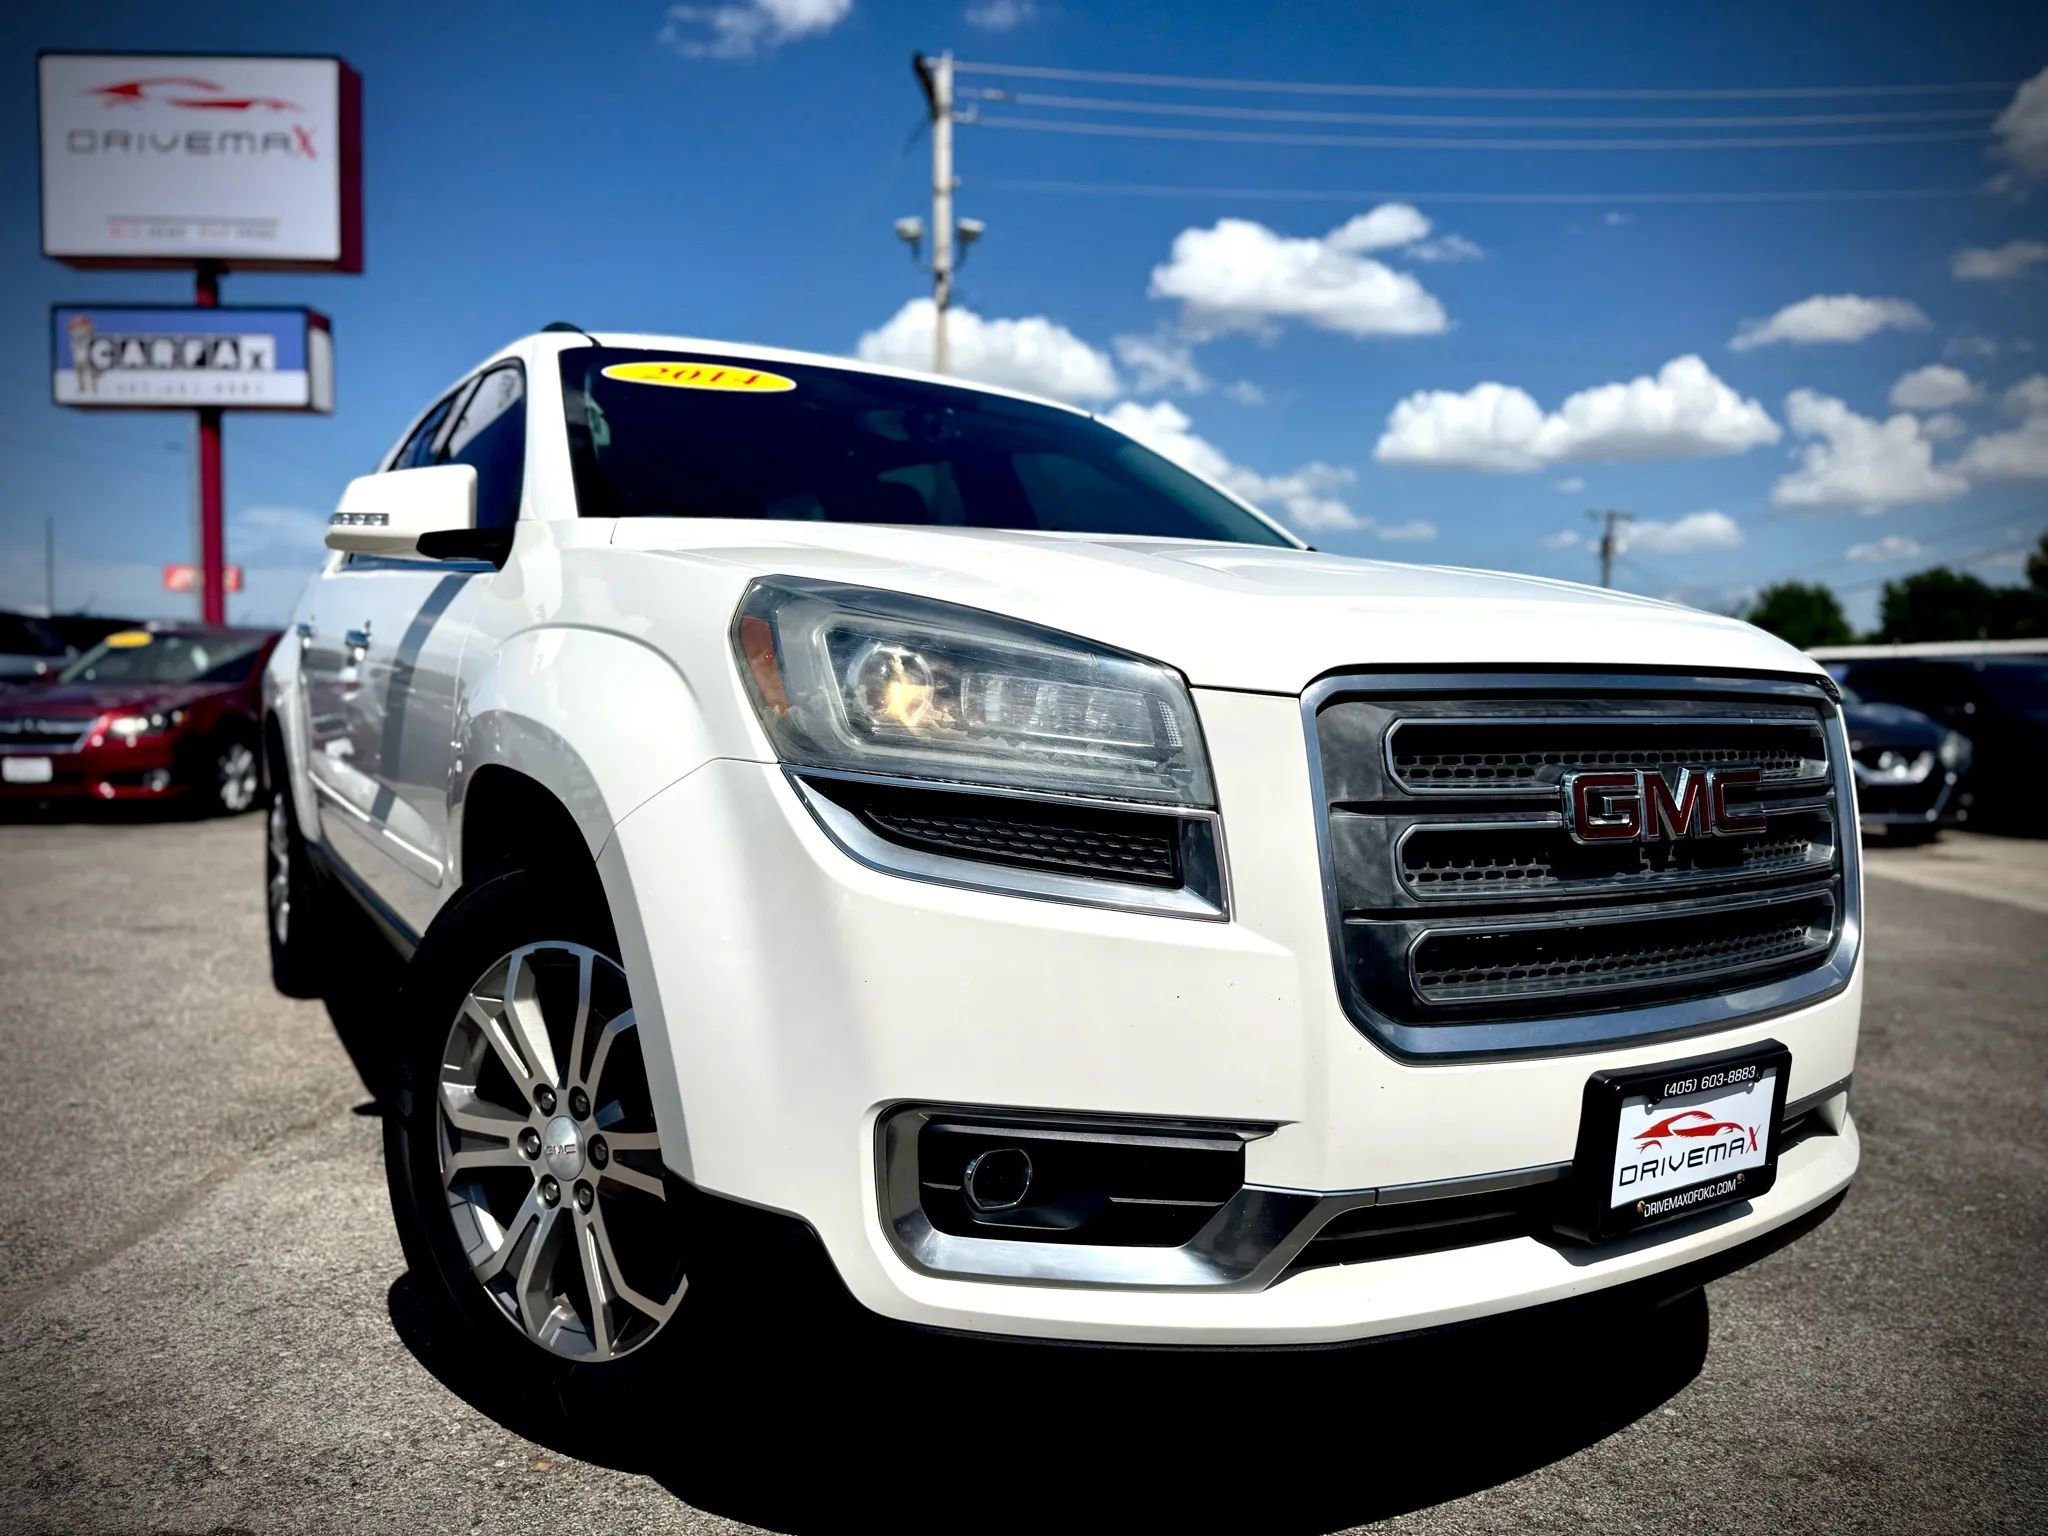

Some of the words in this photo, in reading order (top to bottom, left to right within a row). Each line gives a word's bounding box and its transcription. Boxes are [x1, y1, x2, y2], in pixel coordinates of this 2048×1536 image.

[66, 125, 317, 159] DRIVEMAX
[90, 336, 268, 371] CARFAX
[641, 367, 760, 385] 2014
[1561, 766, 1767, 844] GMC
[1664, 1078, 1697, 1097] (405)
[1701, 1065, 1756, 1090] 603-8883
[546, 1143, 576, 1156] GMC
[1619, 1124, 1761, 1187] DRIVEMAX
[1643, 1178, 1737, 1218] DRIVEMAXOFOKC.COM
